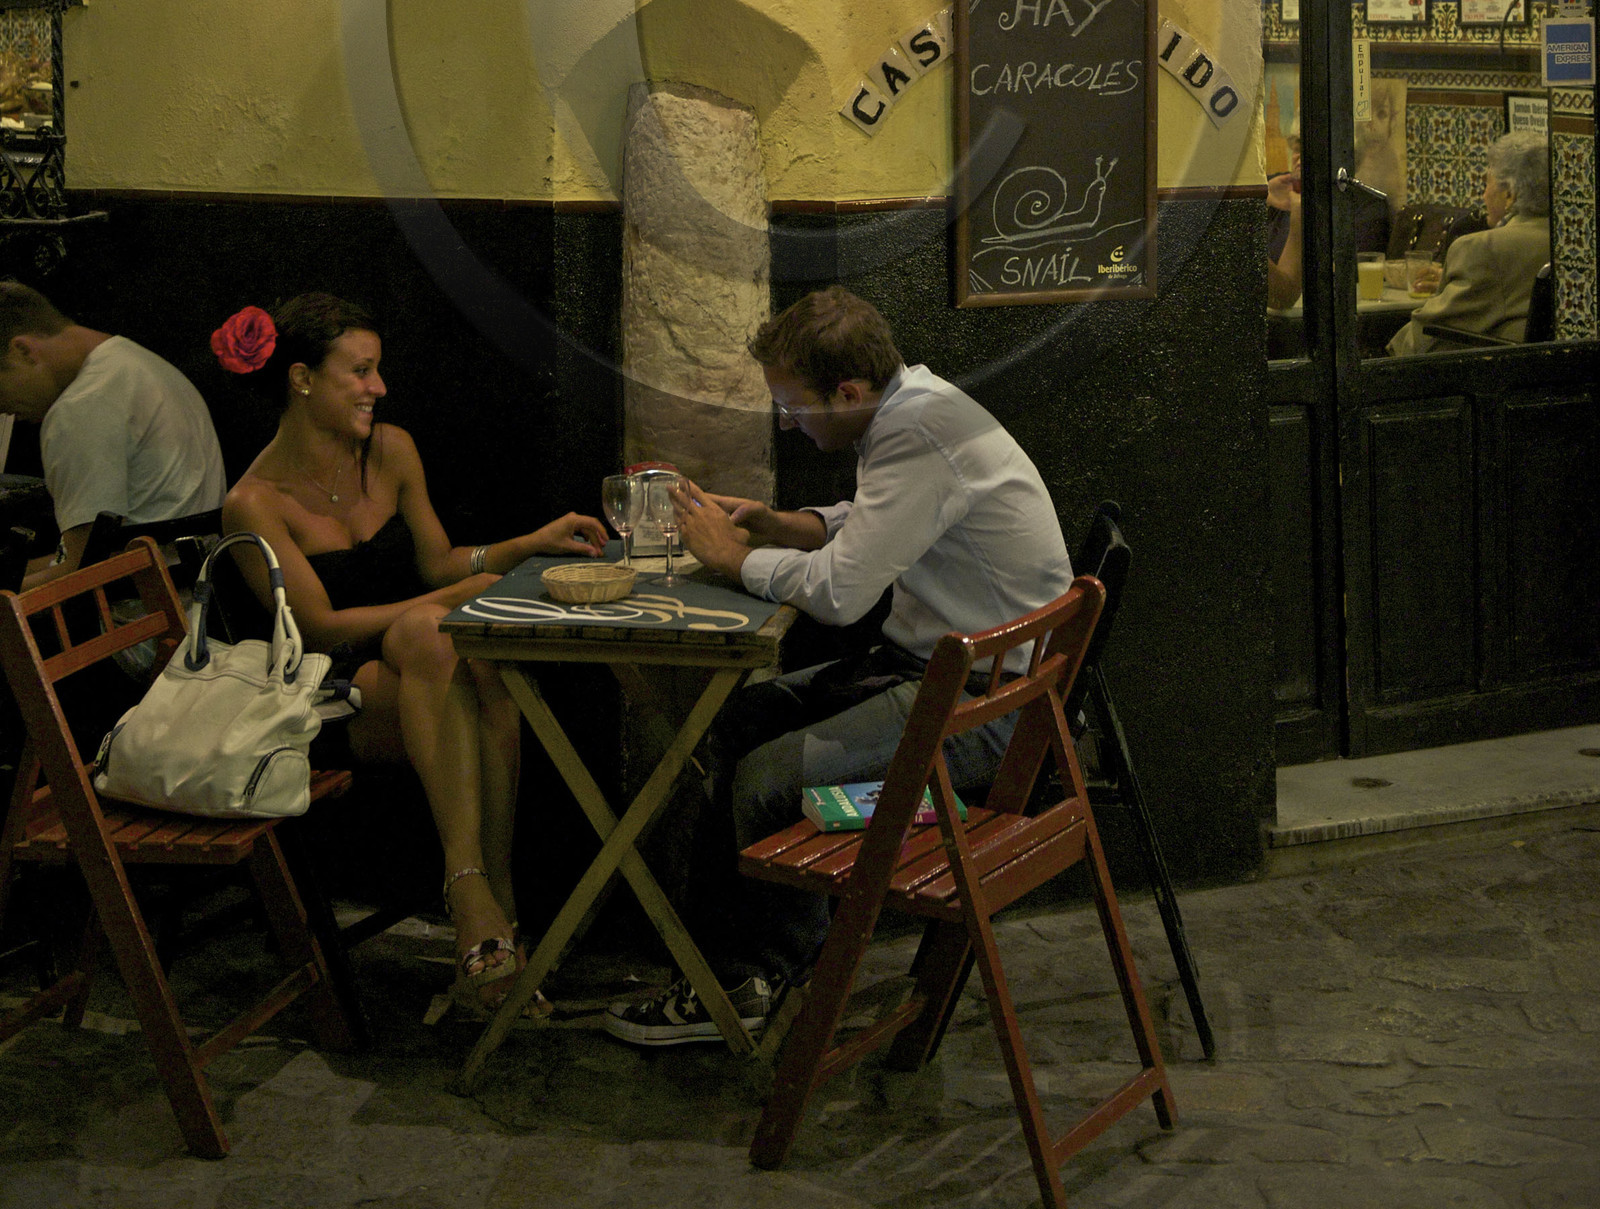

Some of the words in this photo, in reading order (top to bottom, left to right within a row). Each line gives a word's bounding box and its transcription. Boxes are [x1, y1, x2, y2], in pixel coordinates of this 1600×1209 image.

[1547, 43, 1588, 53] AMERICAN
[1555, 54, 1591, 64] EXPRESS
[970, 60, 1143, 96] CARACOLES
[1000, 247, 1092, 287] SNAIL
